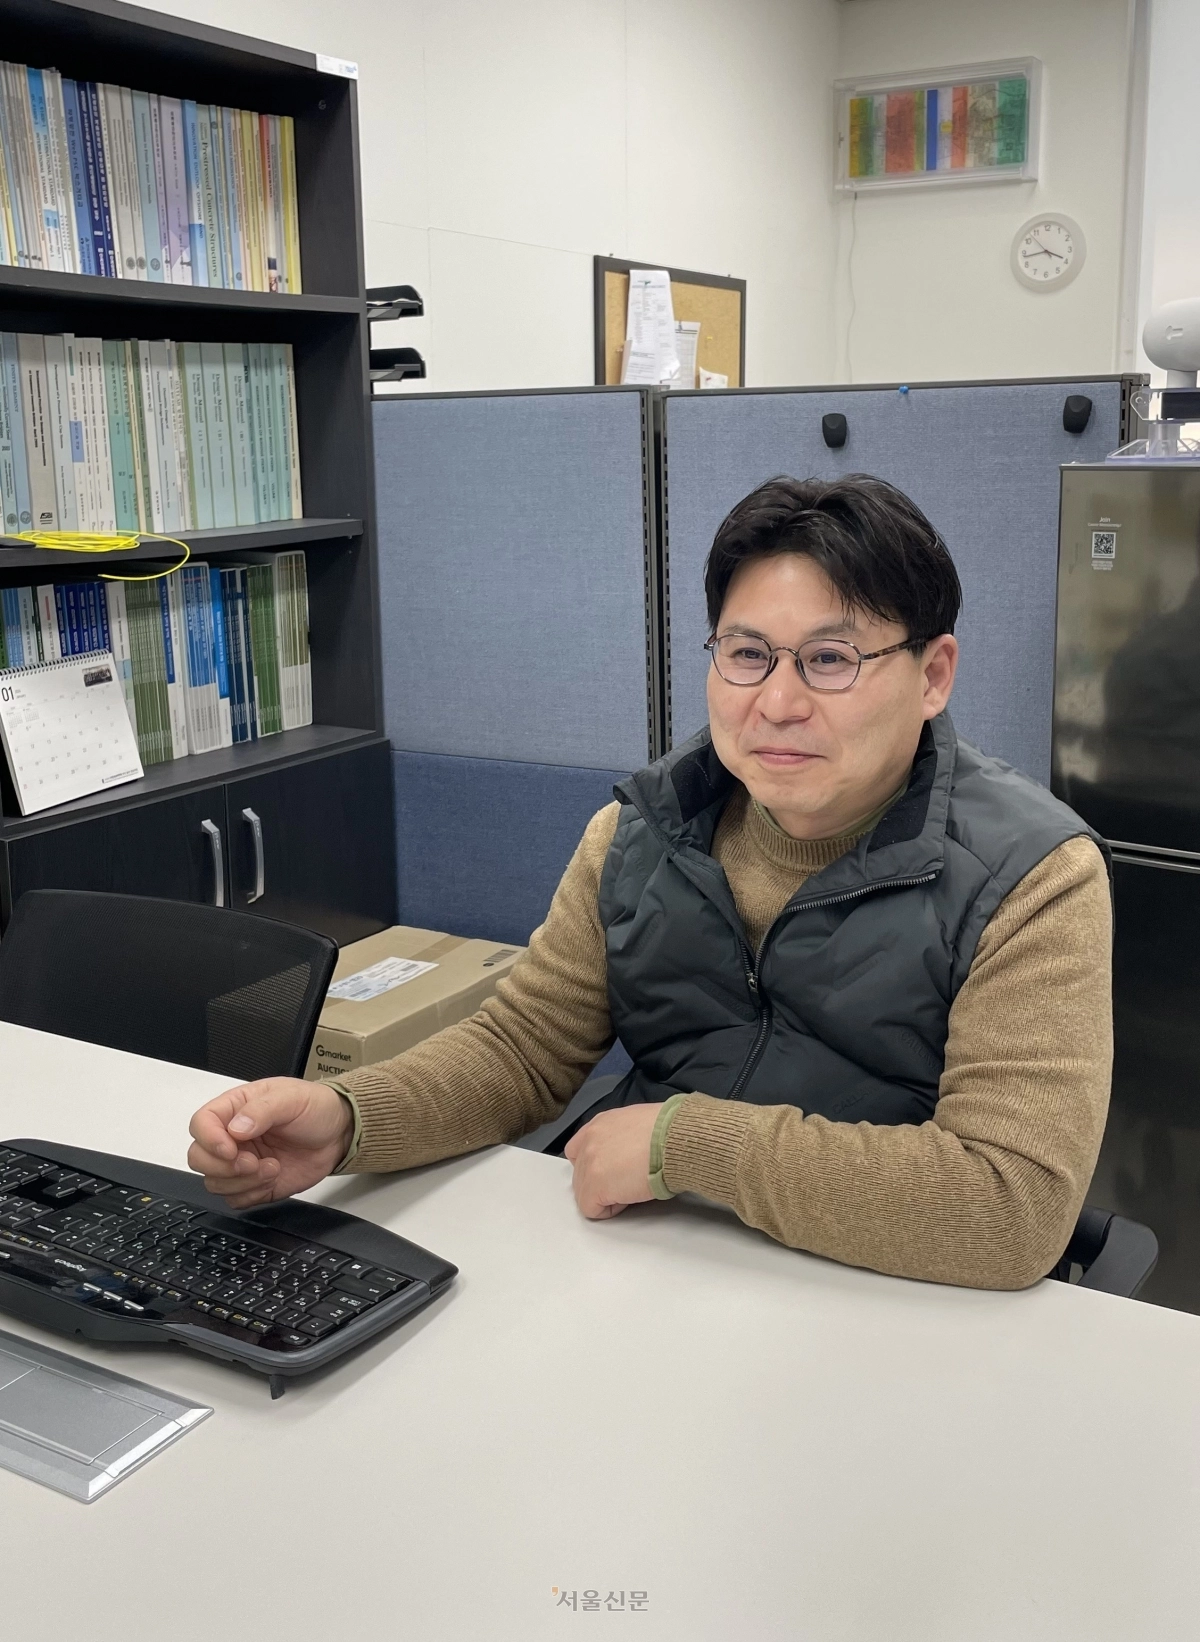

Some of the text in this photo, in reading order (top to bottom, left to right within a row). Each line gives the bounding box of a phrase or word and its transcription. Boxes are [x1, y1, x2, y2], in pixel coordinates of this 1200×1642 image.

[43, 135, 53, 175] INTERNATIONAL
[202, 142, 212, 190] Prestressed
[2, 686, 14, 702] 01
[316, 1045, 352, 1062] Gmarket
